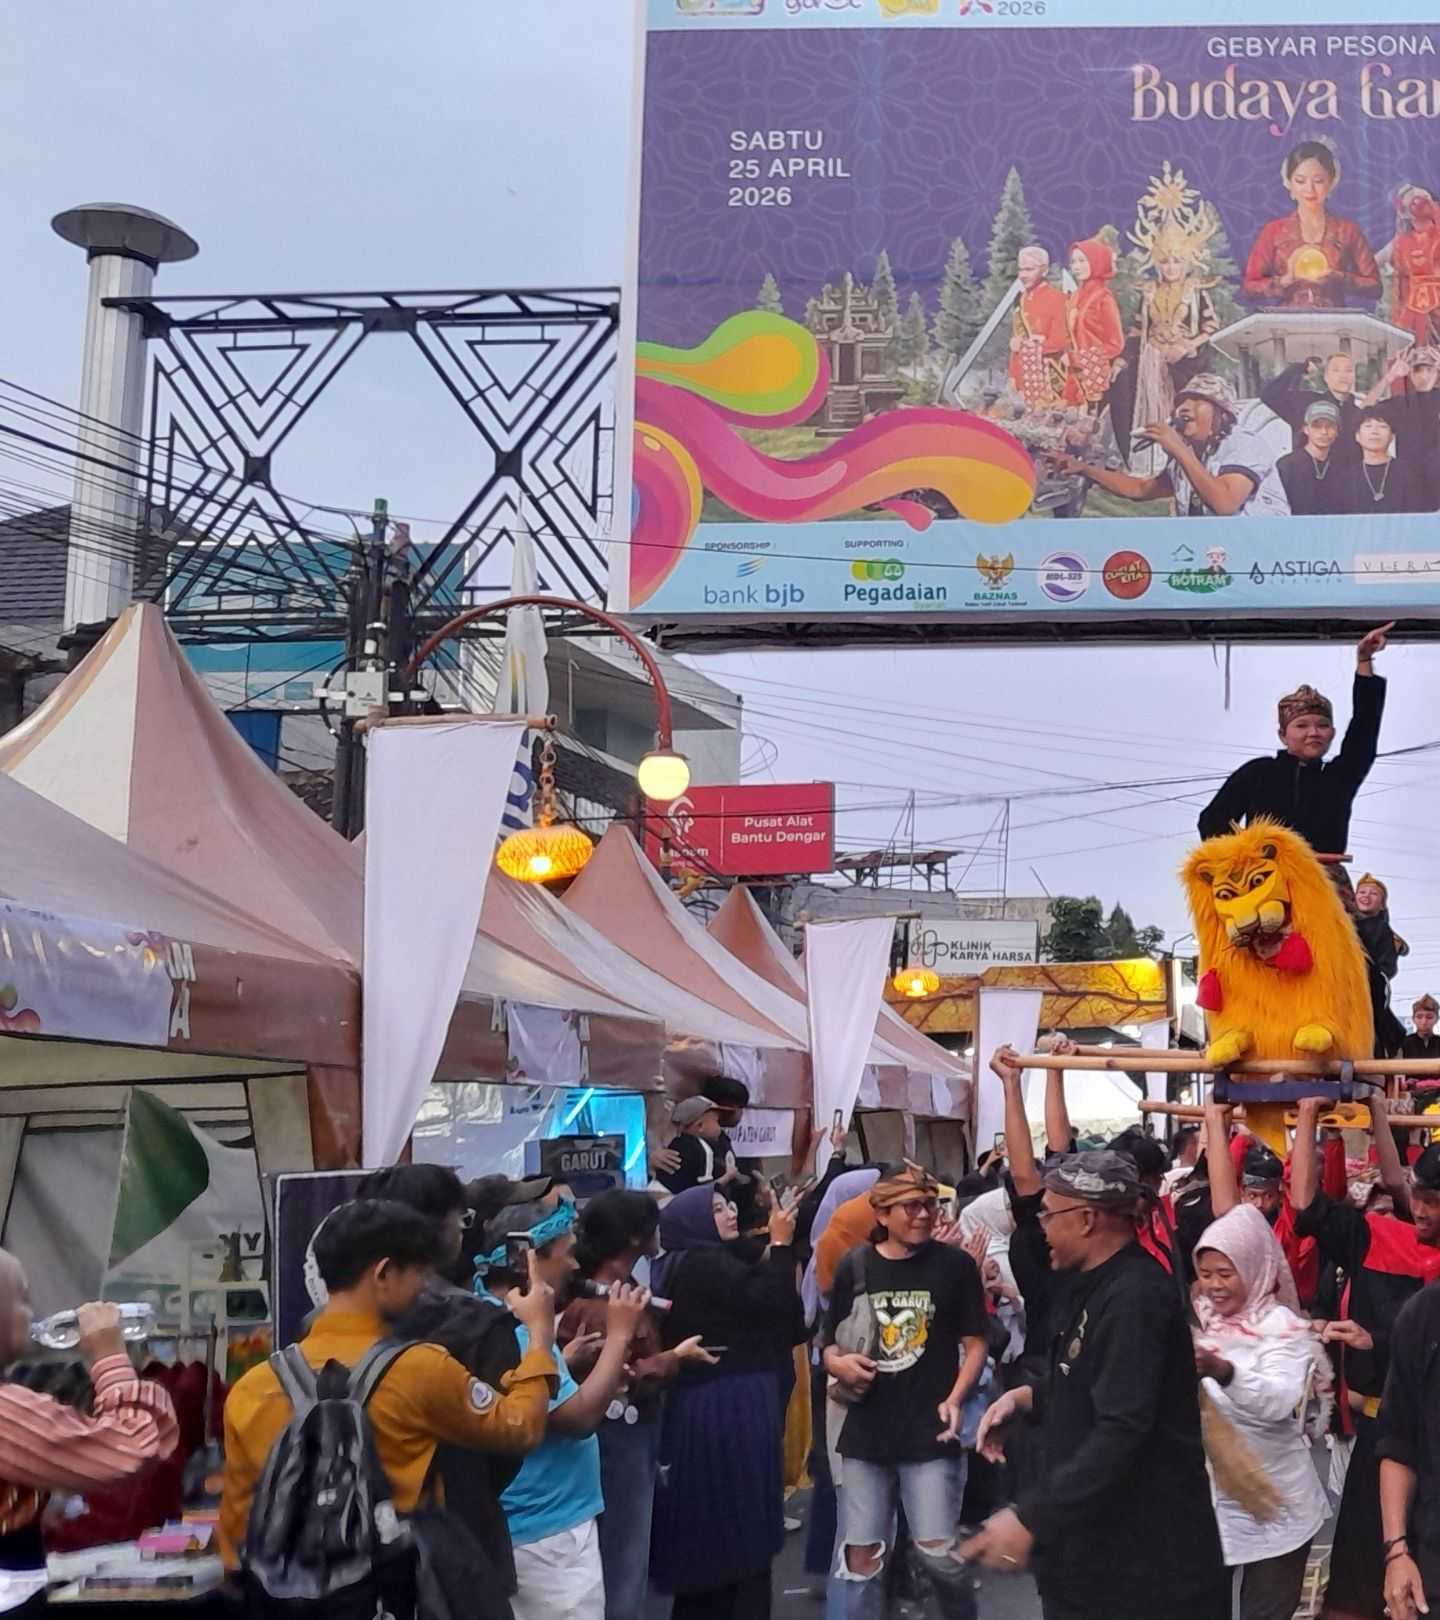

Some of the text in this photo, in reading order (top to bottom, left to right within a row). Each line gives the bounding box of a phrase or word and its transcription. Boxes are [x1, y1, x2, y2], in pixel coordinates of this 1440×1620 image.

[1207, 35, 1436, 57] GEBYAR PESONA
[1130, 63, 1342, 137] Budaya
[729, 130, 823, 151] SABTU
[728, 158, 851, 179] 25 APRIL
[728, 186, 792, 207] 2026
[704, 542, 771, 551] SPONSORSHIP
[844, 540, 904, 549] SUPPORTING
[1271, 560, 1343, 576] ASTIGA
[704, 583, 805, 607] bank bjb
[844, 583, 947, 606] Pegadaian
[974, 592, 1018, 600] BAZNAS
[744, 815, 813, 828] Pusat Alat
[731, 831, 826, 844] Bantu Dengar
[950, 940, 992, 951] KLINIK
[950, 951, 1033, 962] KARYA HARSA
[560, 1151, 608, 1172] GARUT
[891, 1295, 929, 1311] GARUT
